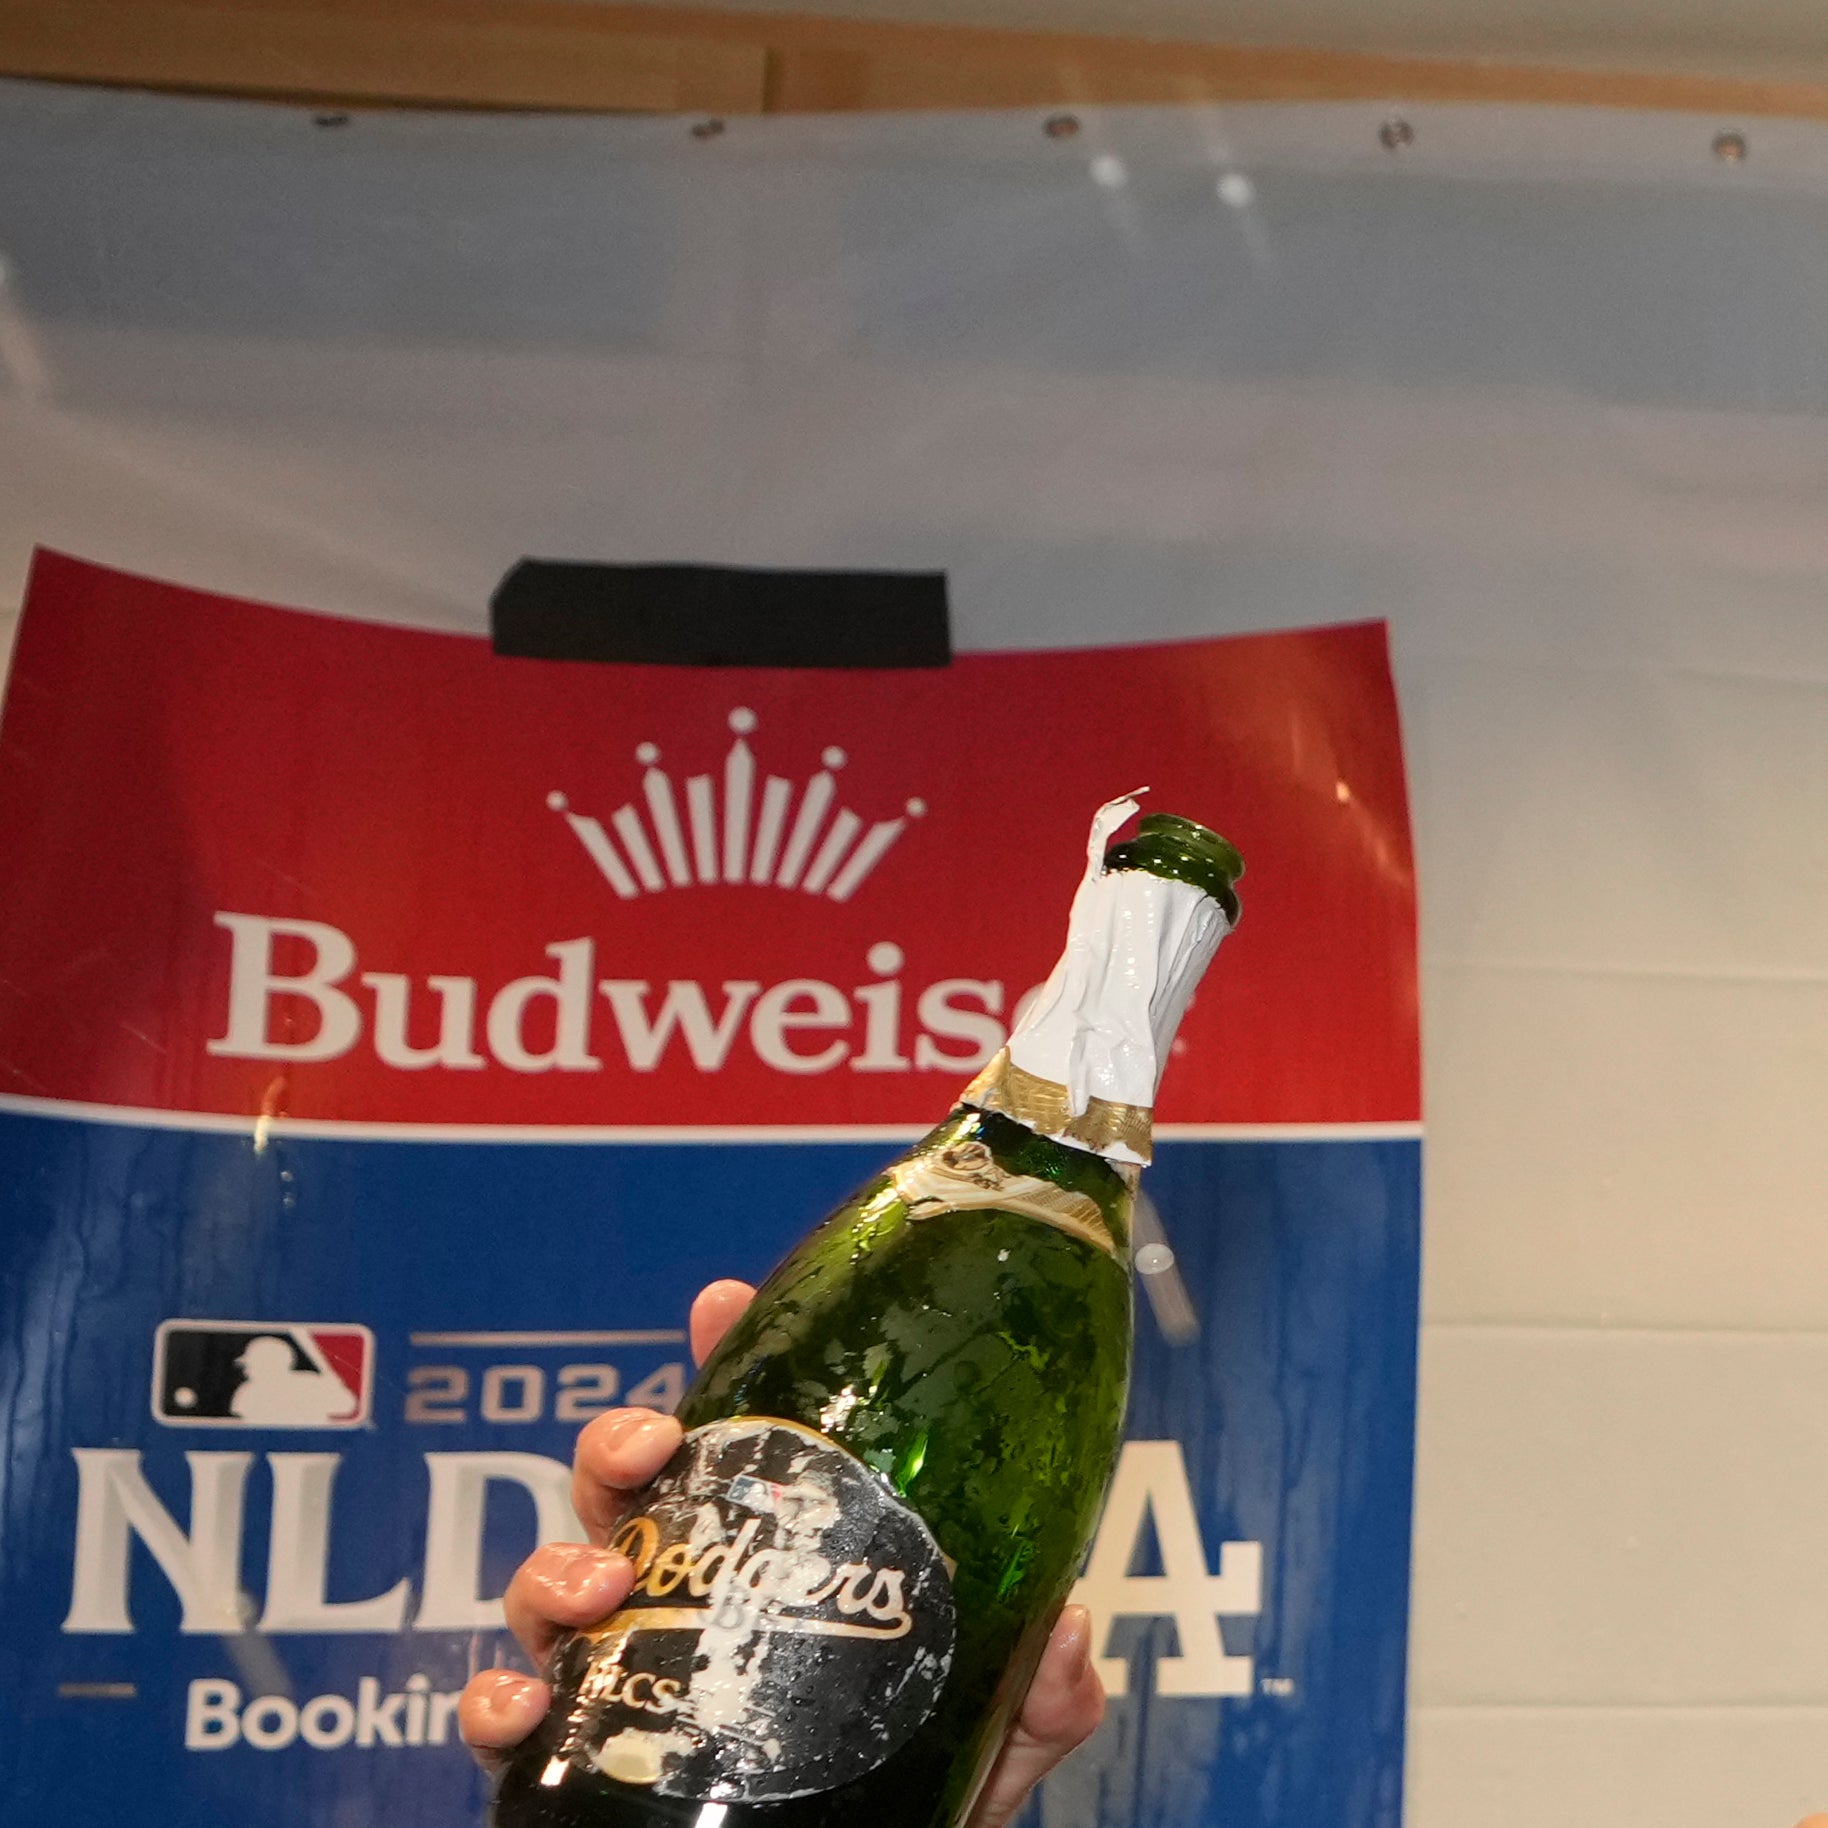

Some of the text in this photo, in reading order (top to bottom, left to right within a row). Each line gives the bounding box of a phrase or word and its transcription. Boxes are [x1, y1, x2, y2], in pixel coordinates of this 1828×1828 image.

[206, 912, 1192, 1073] Budweis
[405, 1363, 690, 1423] 2024
[60, 1447, 592, 1634] NLD
[184, 1673, 466, 1750] Bookin
